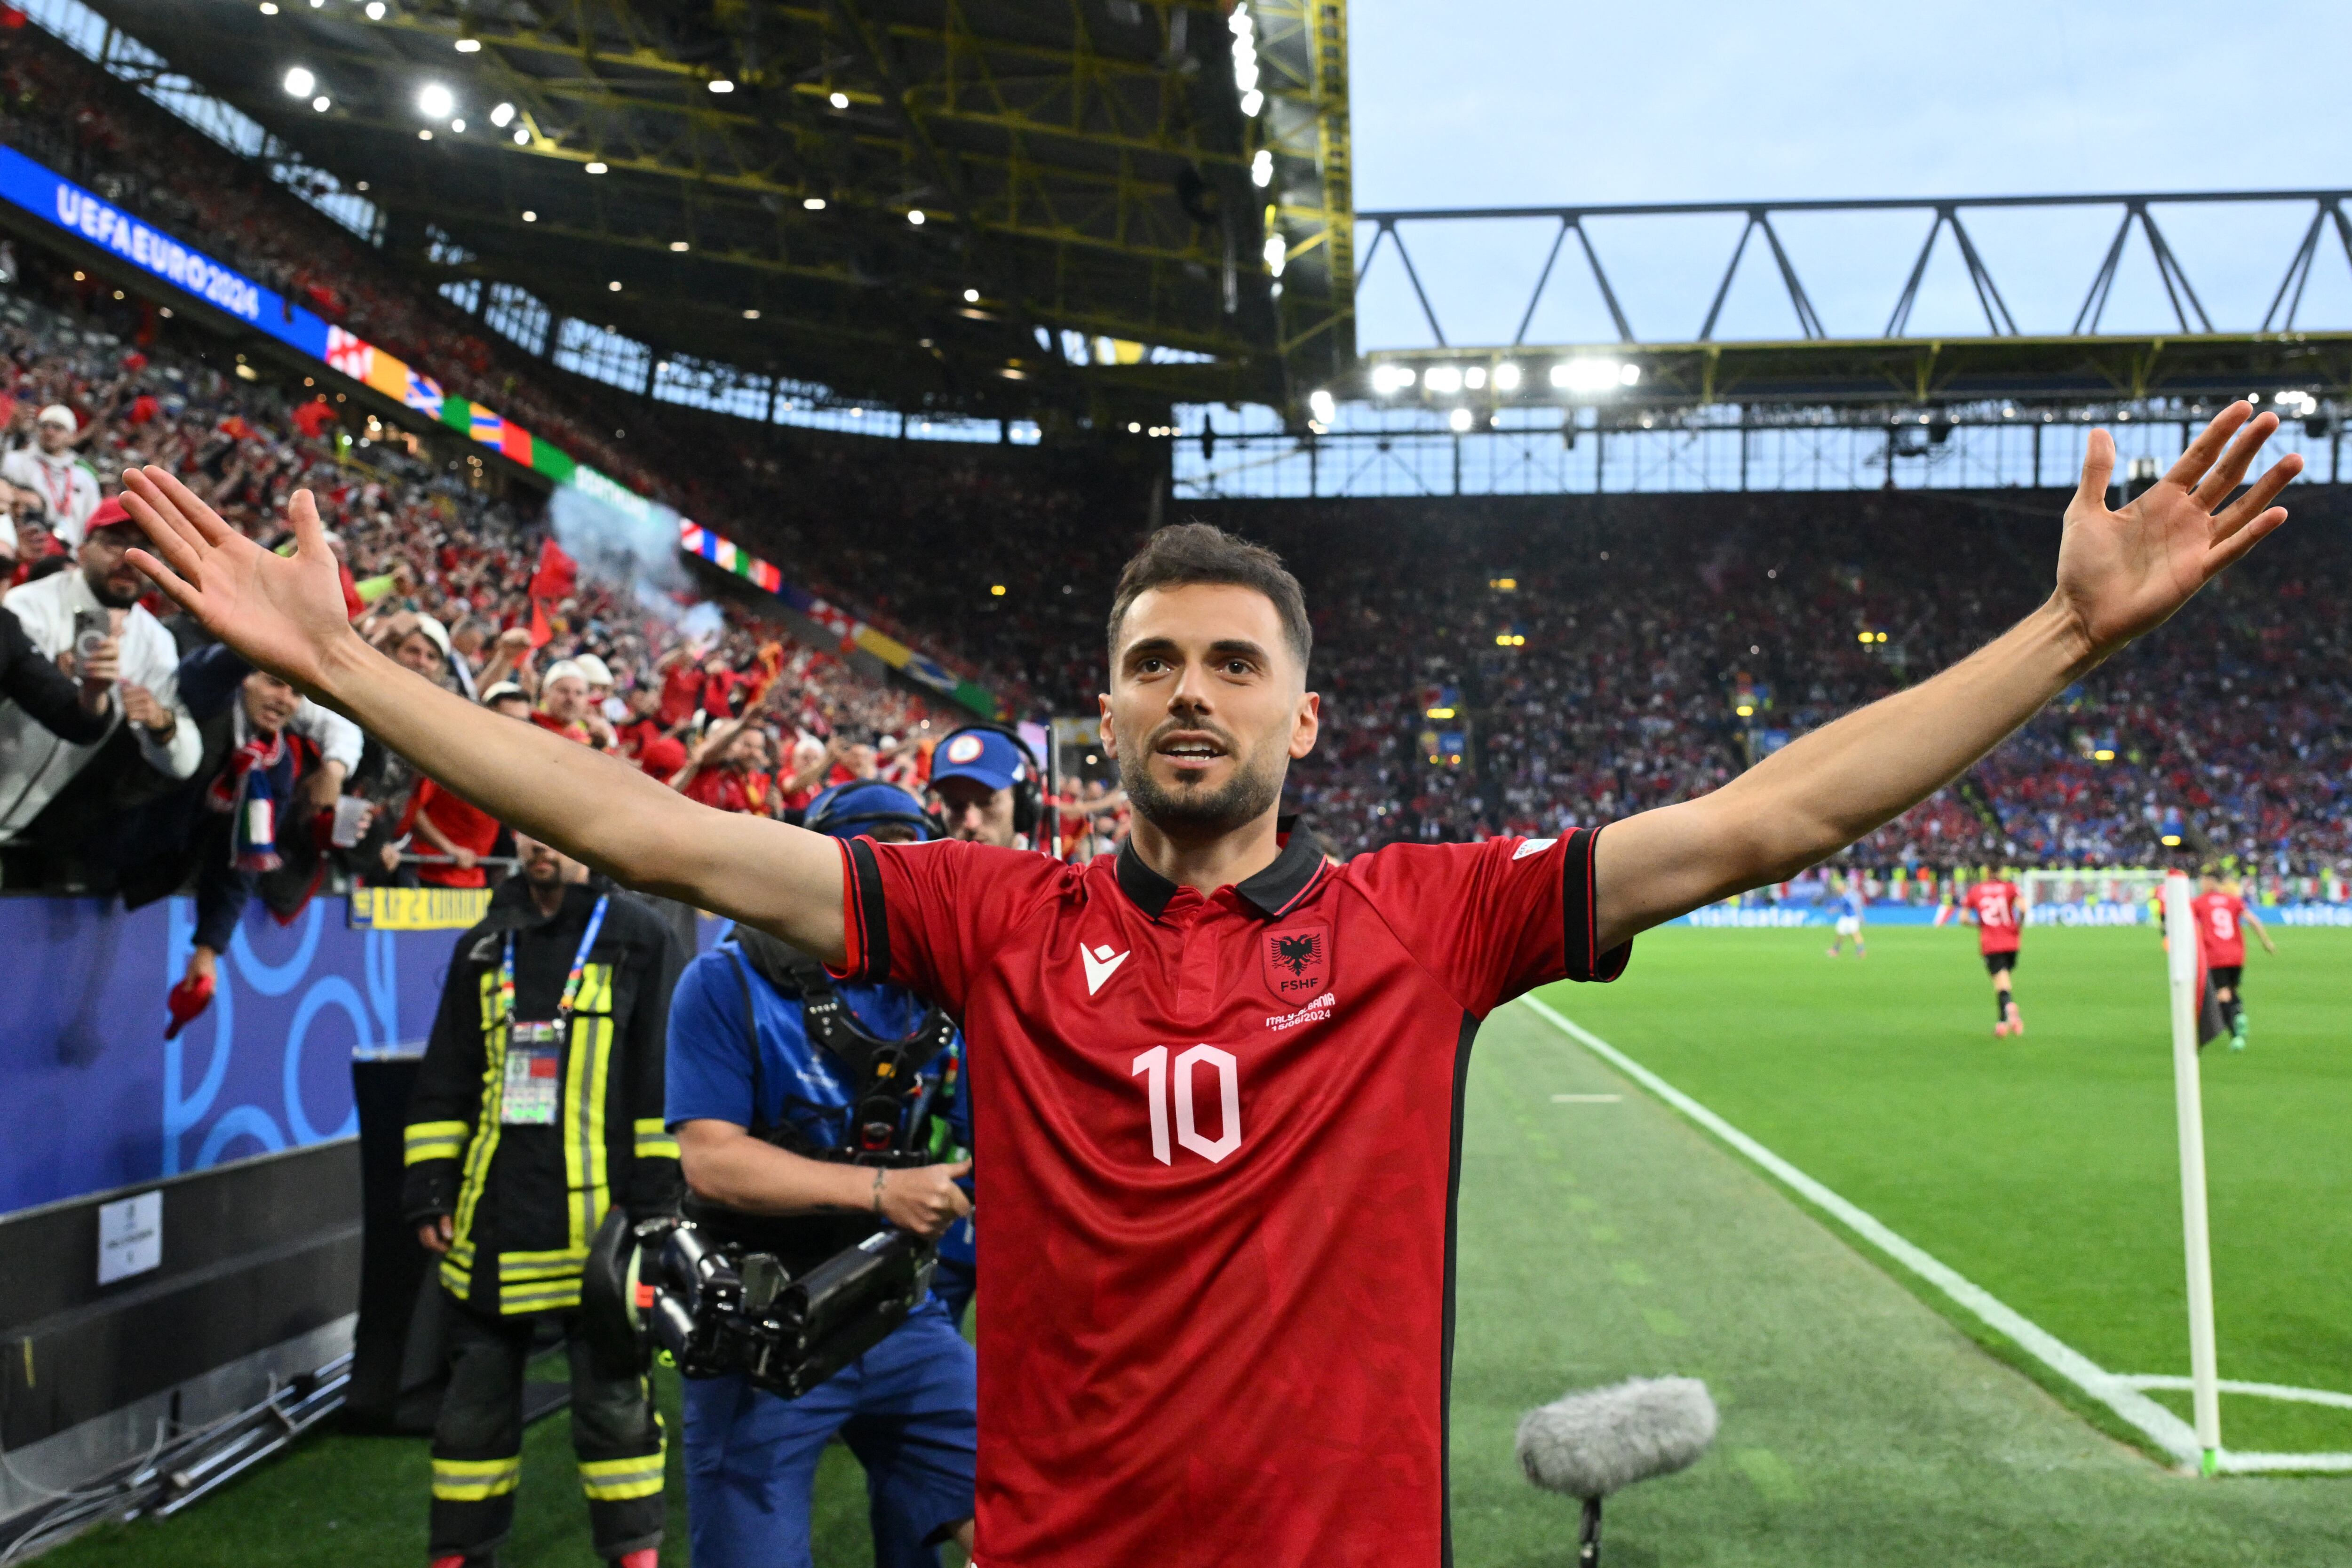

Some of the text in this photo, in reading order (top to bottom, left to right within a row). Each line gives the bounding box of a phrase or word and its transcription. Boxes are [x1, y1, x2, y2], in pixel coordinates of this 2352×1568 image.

[1979, 895, 2011, 927] 21
[2211, 907, 2234, 940] 9
[1280, 978, 1318, 992] FSHF
[1271, 1009, 1331, 1031] 15/06/2024
[1132, 1043, 1241, 1166] 10
